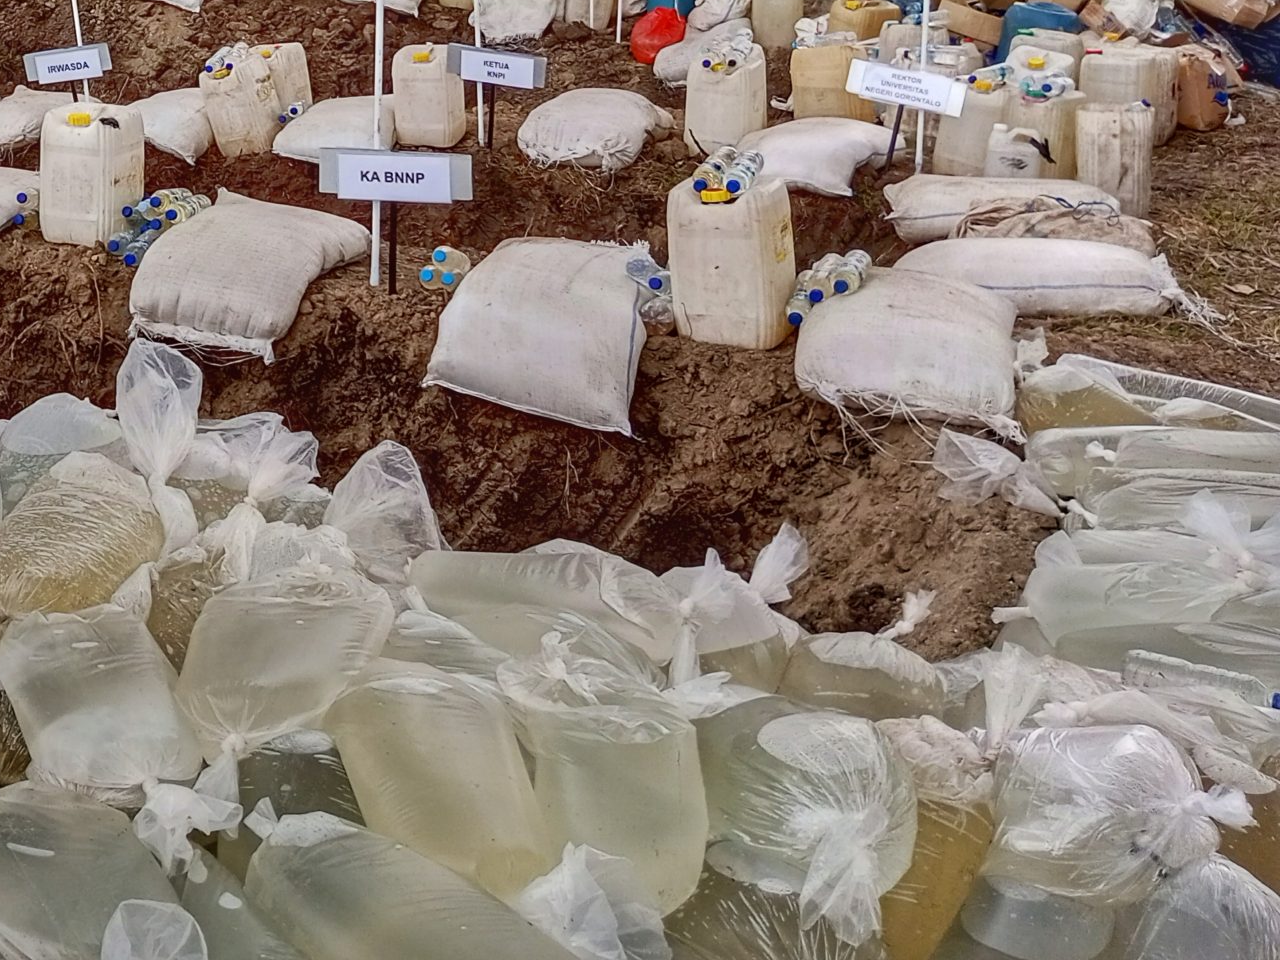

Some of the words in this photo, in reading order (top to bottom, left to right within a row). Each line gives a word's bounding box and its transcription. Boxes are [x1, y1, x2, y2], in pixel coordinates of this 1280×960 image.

[47, 61, 90, 74] IRWASDA
[483, 60, 510, 70] KETUA
[487, 70, 506, 79] KNPI
[891, 72, 922, 85] REKTOR
[880, 79, 929, 95] UNIVERSITAS
[864, 85, 893, 97] NEGERI
[894, 91, 942, 107] GORONTALO
[360, 170, 381, 183] KA
[384, 171, 425, 184] BNNP
